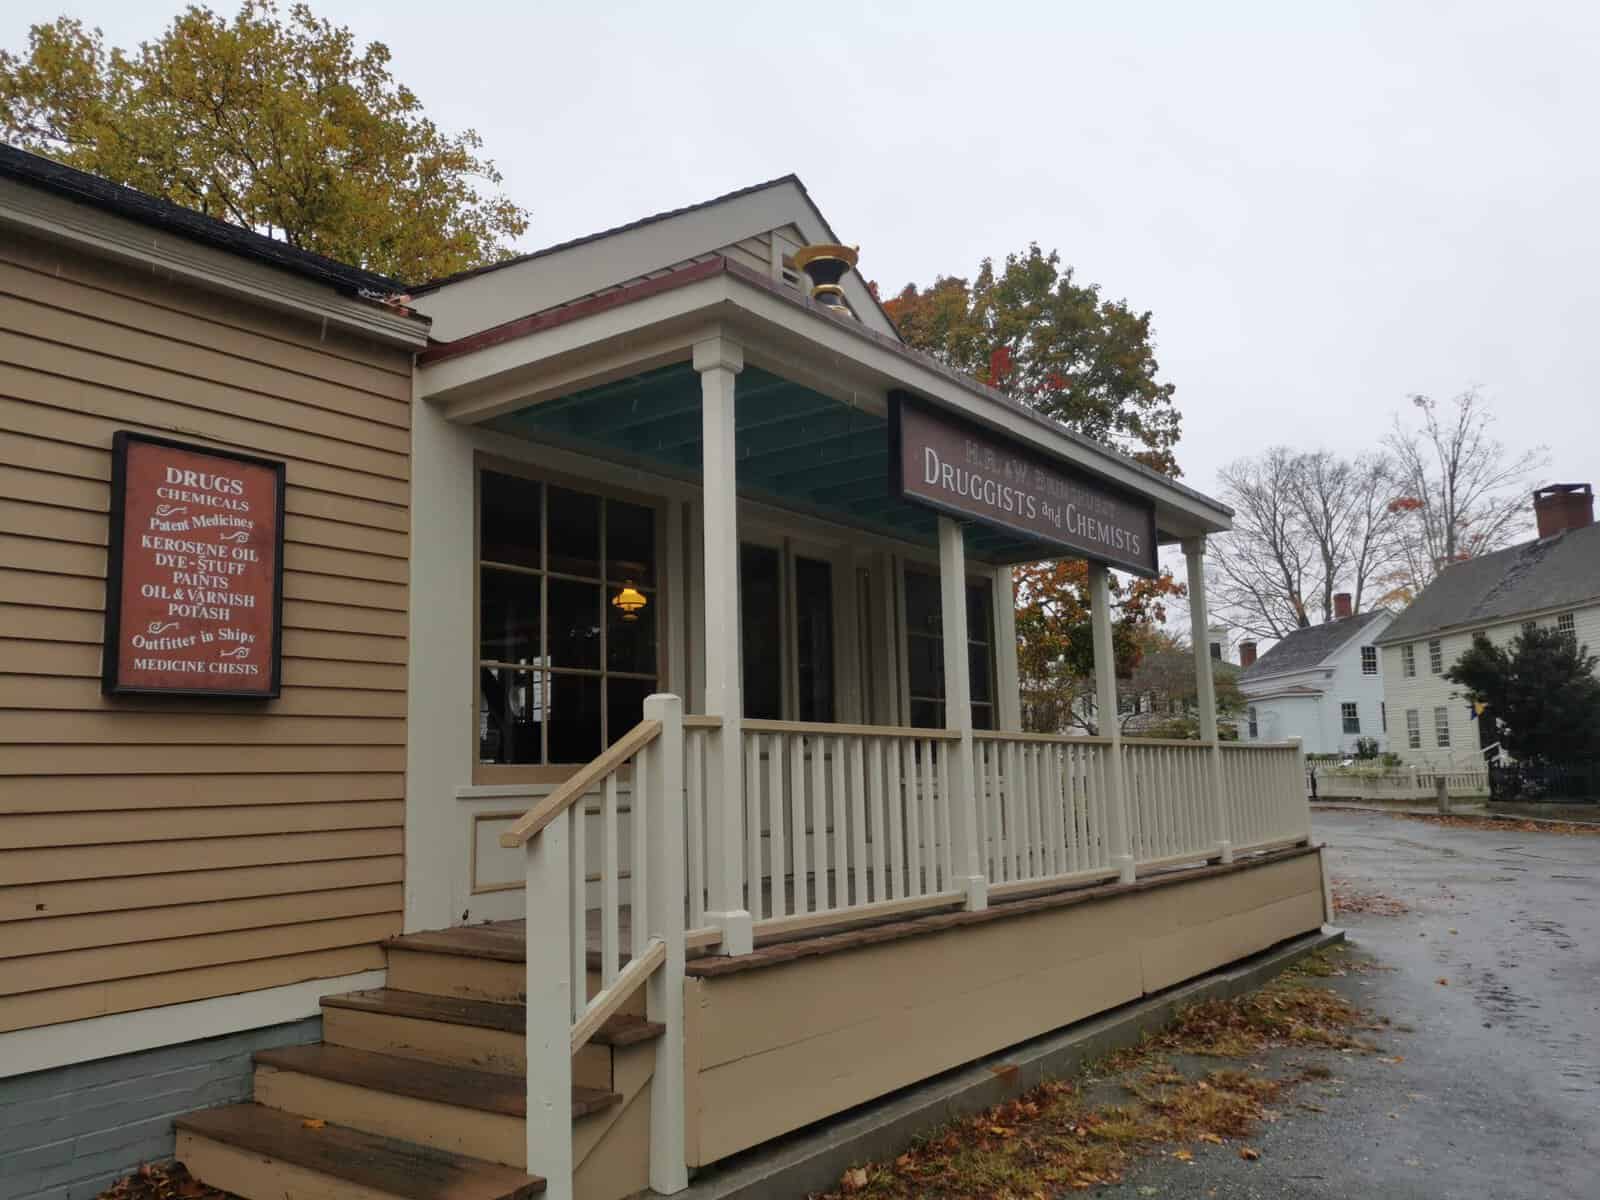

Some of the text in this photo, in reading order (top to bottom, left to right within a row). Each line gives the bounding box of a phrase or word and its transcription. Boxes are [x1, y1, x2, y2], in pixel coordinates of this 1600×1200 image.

[165, 467, 243, 495] DRUGS
[156, 487, 249, 512] CHEMICALS
[924, 447, 1036, 520] DRUGGISTS
[1042, 502, 1061, 529] and
[1066, 503, 1141, 555] CHEMISTS
[149, 514, 255, 532] Patent Medicines
[142, 535, 259, 562] KEROSENE OIL
[173, 572, 229, 589] PAINTS
[141, 584, 256, 608] OIL & VARNISH
[168, 603, 230, 621] POTASH
[131, 628, 256, 650] Outfitter in Ships
[134, 658, 259, 675] MEDICINE CHESTS
